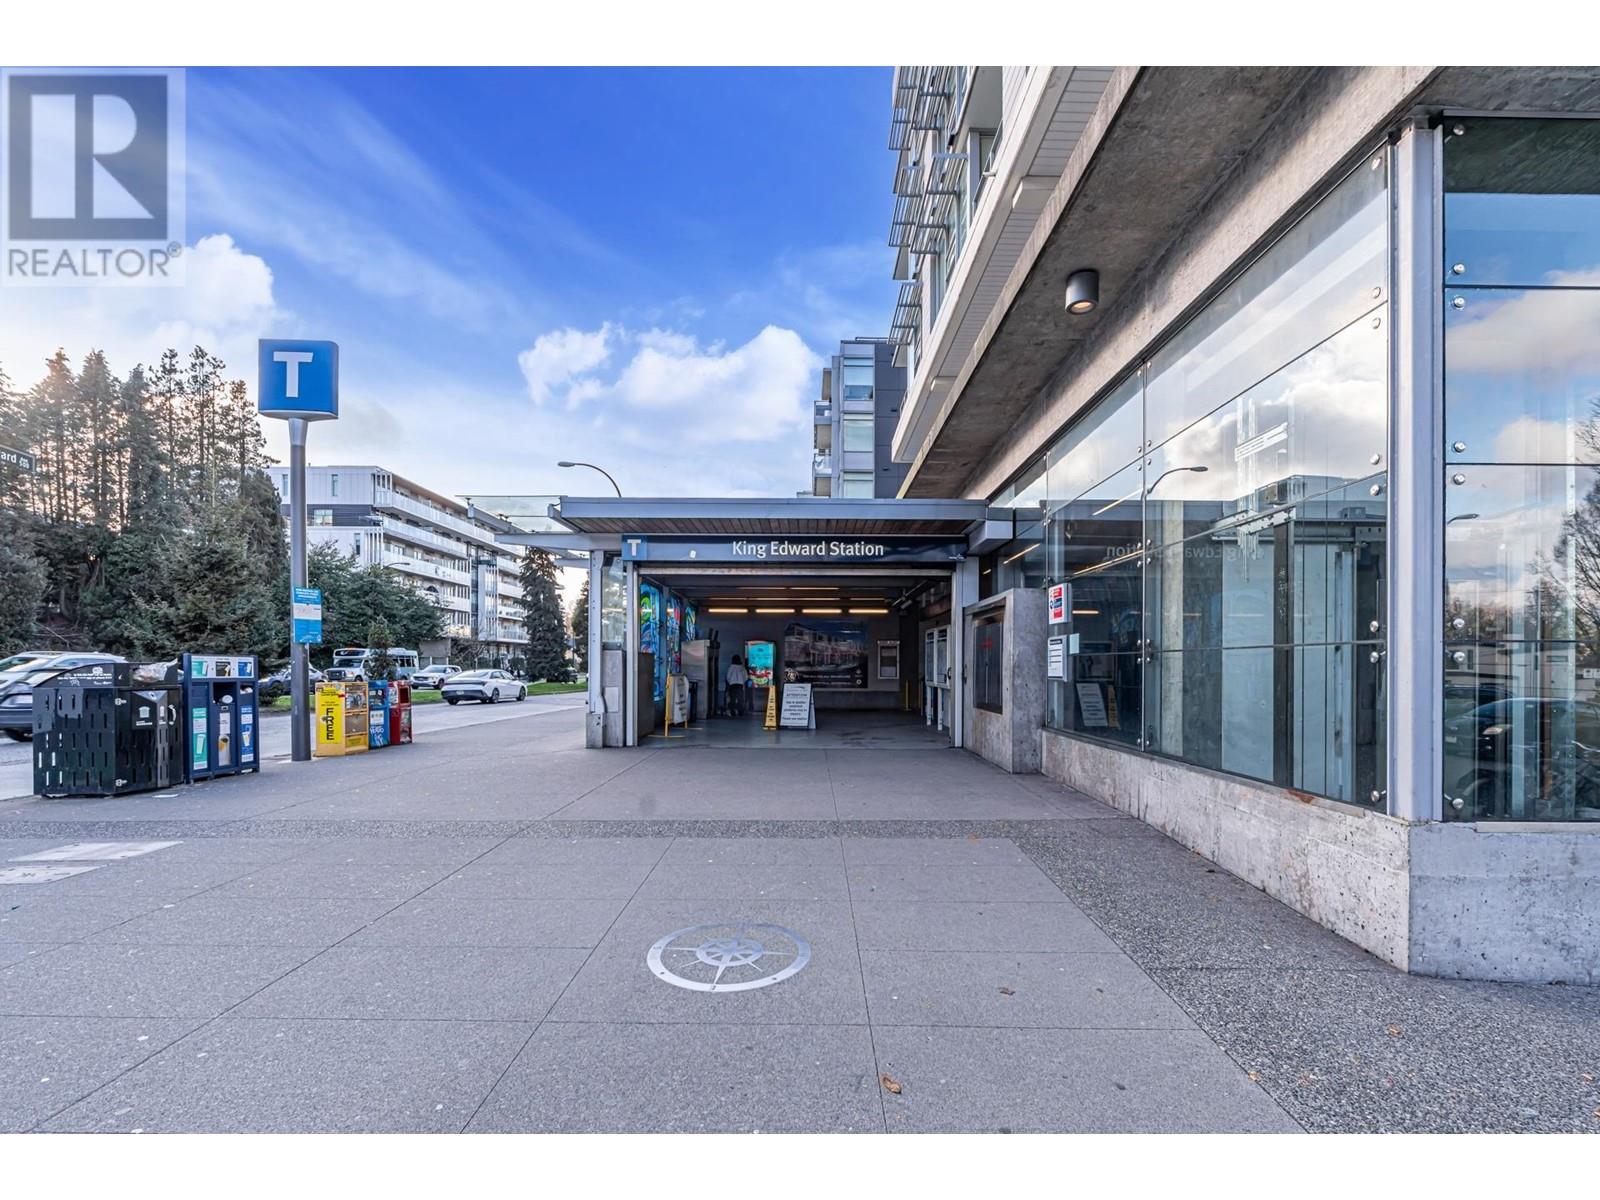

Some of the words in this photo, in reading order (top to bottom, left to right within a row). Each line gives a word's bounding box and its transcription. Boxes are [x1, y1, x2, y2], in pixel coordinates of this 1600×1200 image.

[273, 351, 314, 398] T
[627, 539, 641, 557] T
[732, 541, 767, 558] King
[770, 541, 826, 556] Edward
[829, 541, 884, 556] Station
[326, 707, 335, 741] FREE
